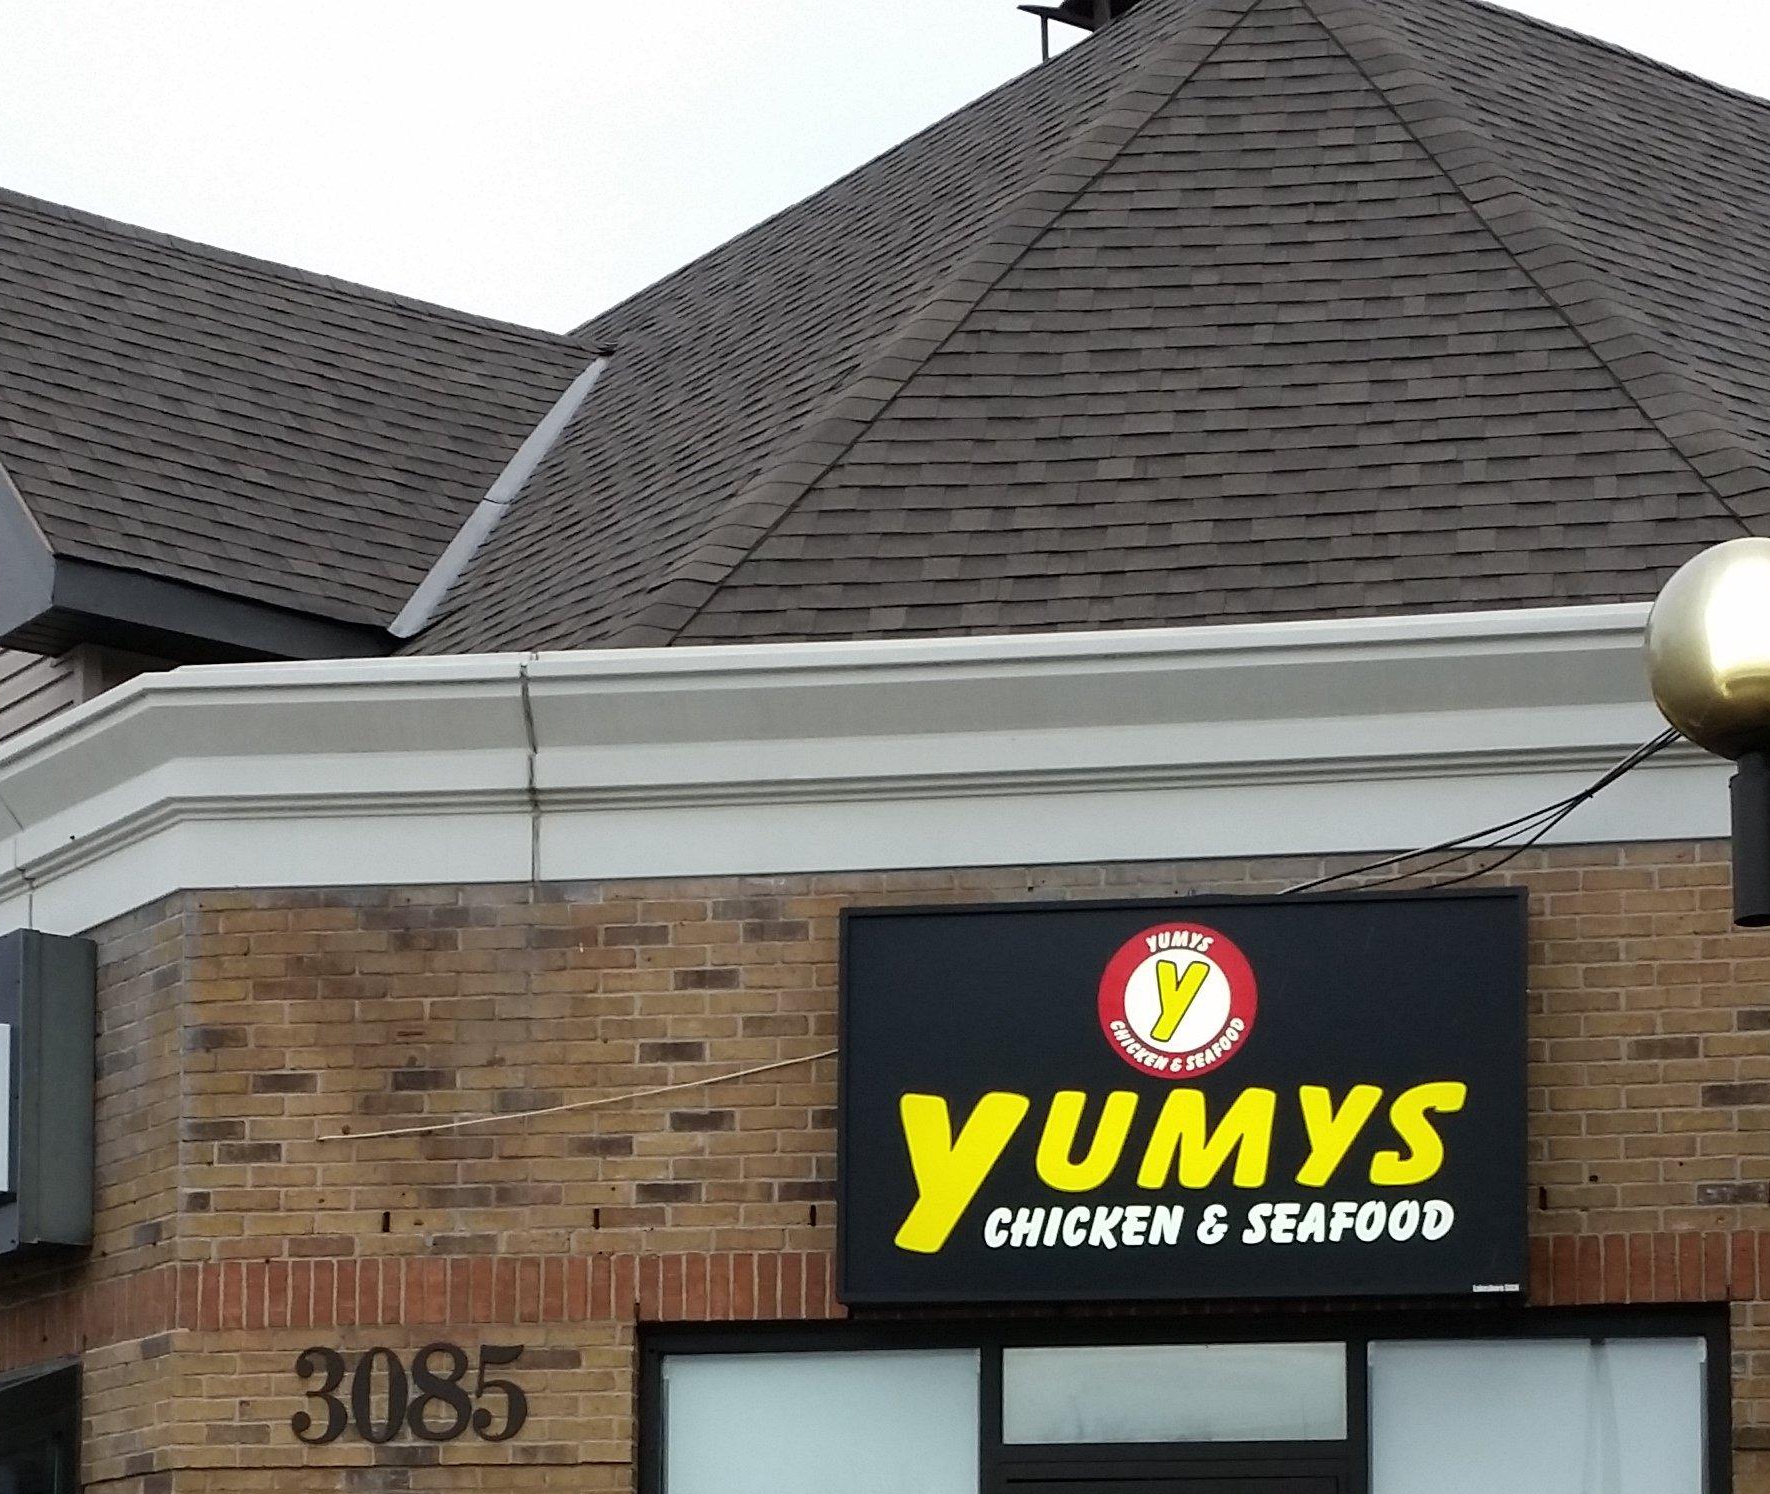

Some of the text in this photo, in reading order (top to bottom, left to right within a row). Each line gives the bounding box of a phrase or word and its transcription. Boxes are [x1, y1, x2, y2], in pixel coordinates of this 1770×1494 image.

[1146, 930, 1214, 953] YUMYS
[1110, 1017, 1245, 1072] CHICKEN & SEAFOOD
[893, 1080, 1468, 1254] YUMYS
[983, 1199, 1455, 1251] CHICKEN & SEAFOOD
[291, 1342, 528, 1445] 3085
